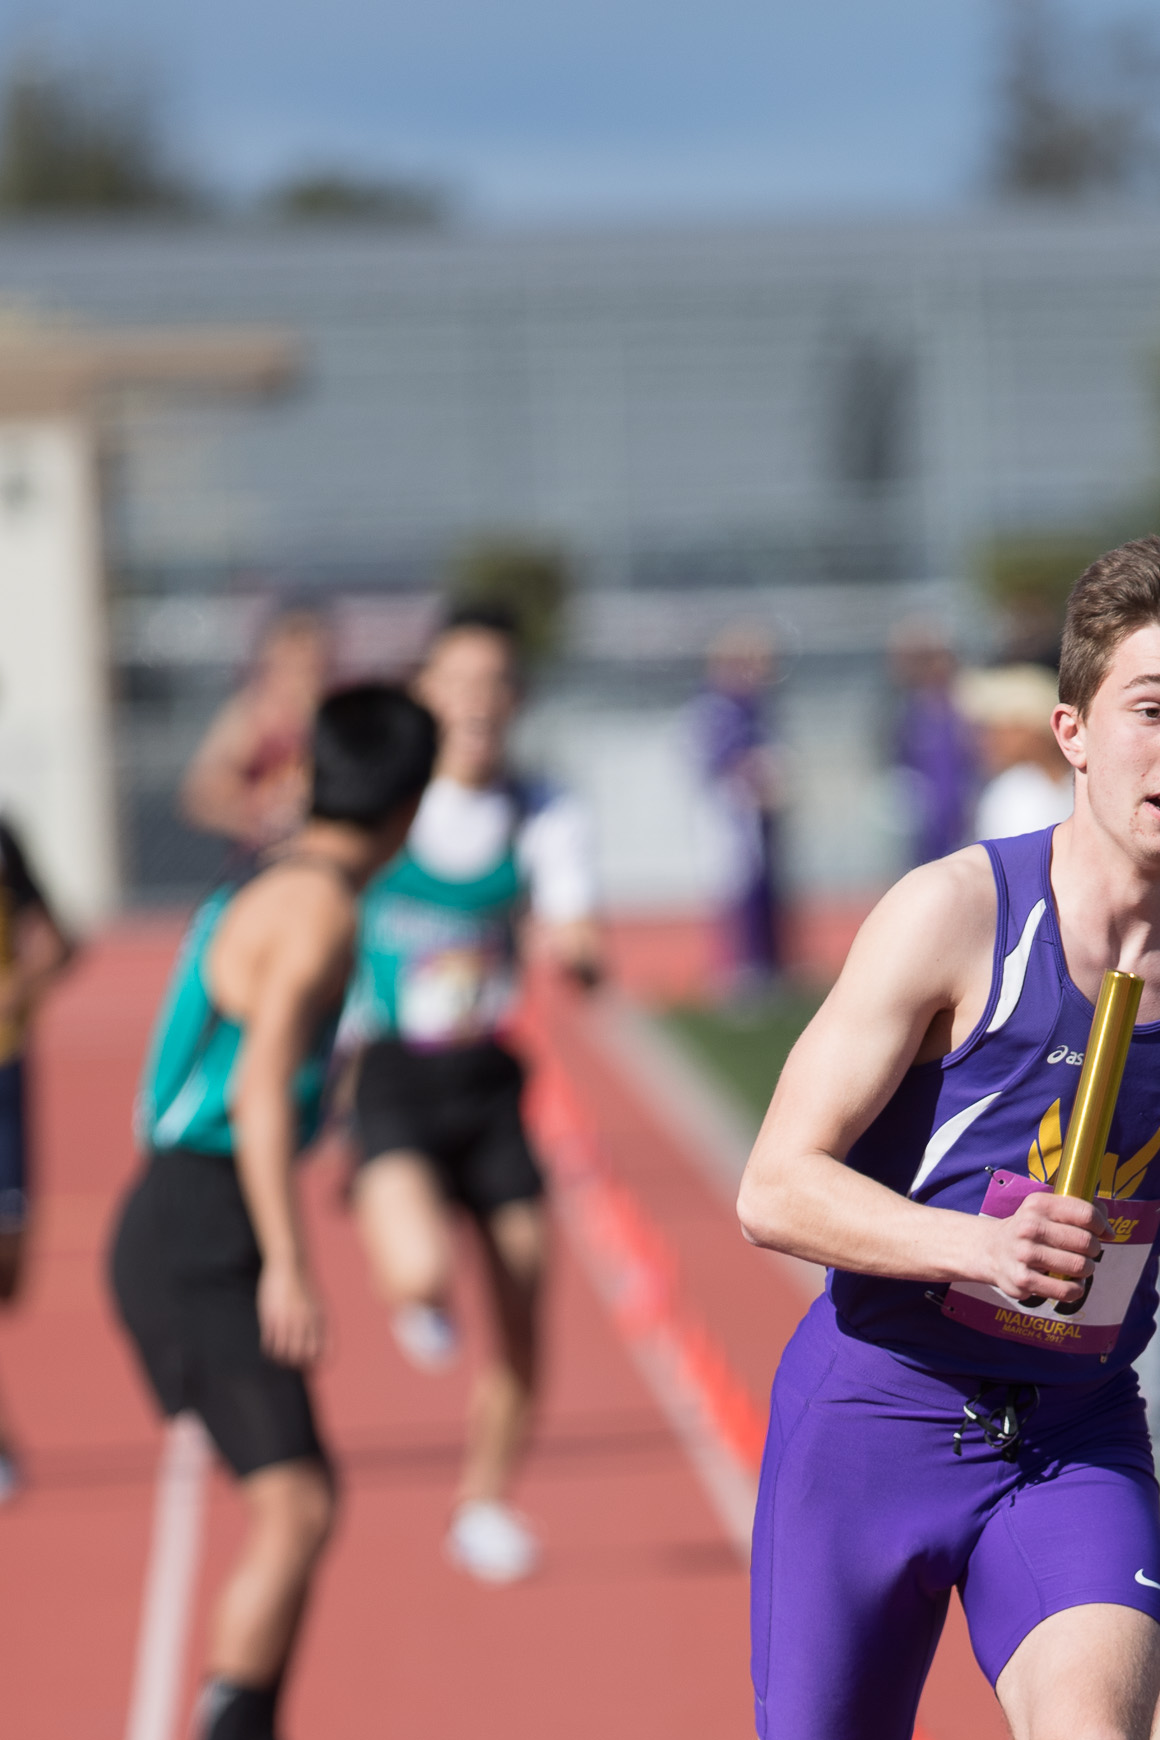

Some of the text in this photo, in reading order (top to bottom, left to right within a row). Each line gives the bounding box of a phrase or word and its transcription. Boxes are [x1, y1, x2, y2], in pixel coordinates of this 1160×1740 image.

[995, 1309, 1082, 1338] INAUGURAL
[1002, 1324, 1034, 1337] MARCH
[1045, 1333, 1065, 1344] 2017
